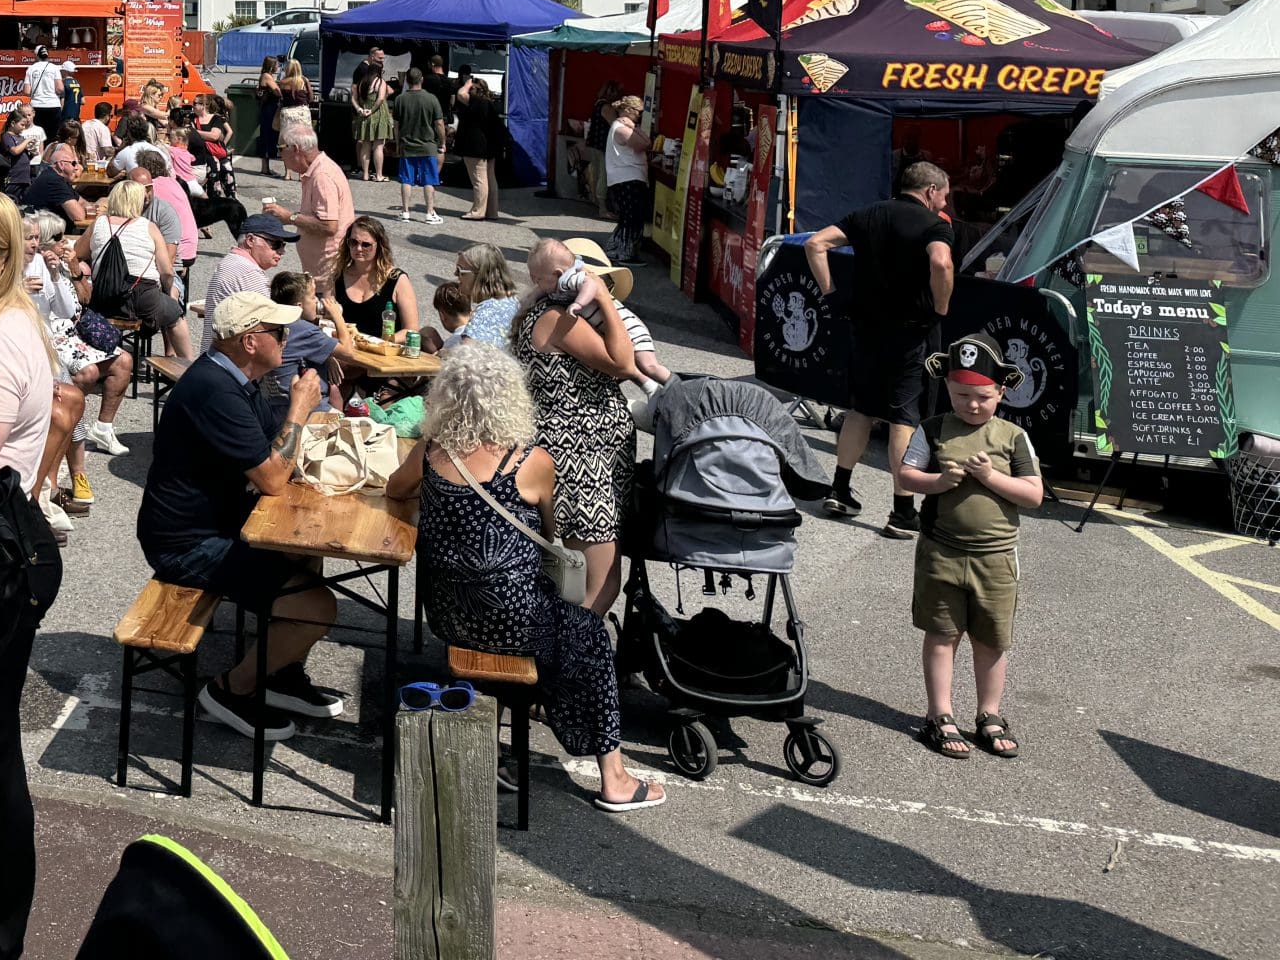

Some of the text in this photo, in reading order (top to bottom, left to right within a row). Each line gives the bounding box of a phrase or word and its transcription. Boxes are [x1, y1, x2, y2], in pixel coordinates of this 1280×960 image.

[882, 62, 989, 91] FRESH
[72, 88, 80, 104] 7
[760, 272, 832, 319] POWDER MONKEY
[1093, 298, 1210, 320] Today's menu
[1127, 325, 1180, 338] DRINKS
[764, 332, 808, 368] BREWING
[1020, 318, 1065, 371] MONKEY
[1124, 342, 1150, 350] TEA
[1127, 351, 1158, 360] COFFEE
[1127, 360, 1172, 370] ESPRESSO
[1127, 369, 1175, 378] CAPUCCINO
[1128, 377, 1162, 386] LATTE
[1129, 388, 1179, 400] AFFOGATO
[1130, 400, 1155, 409] ICED
[1158, 402, 1192, 411] COFFEE
[1132, 410, 1148, 420] ICE
[1152, 413, 1184, 422] CREAM
[1187, 415, 1220, 425] FLOATS
[1132, 422, 1156, 432] SOFT
[1157, 425, 1191, 434] DRINKS
[1135, 434, 1200, 446] WATER £1
